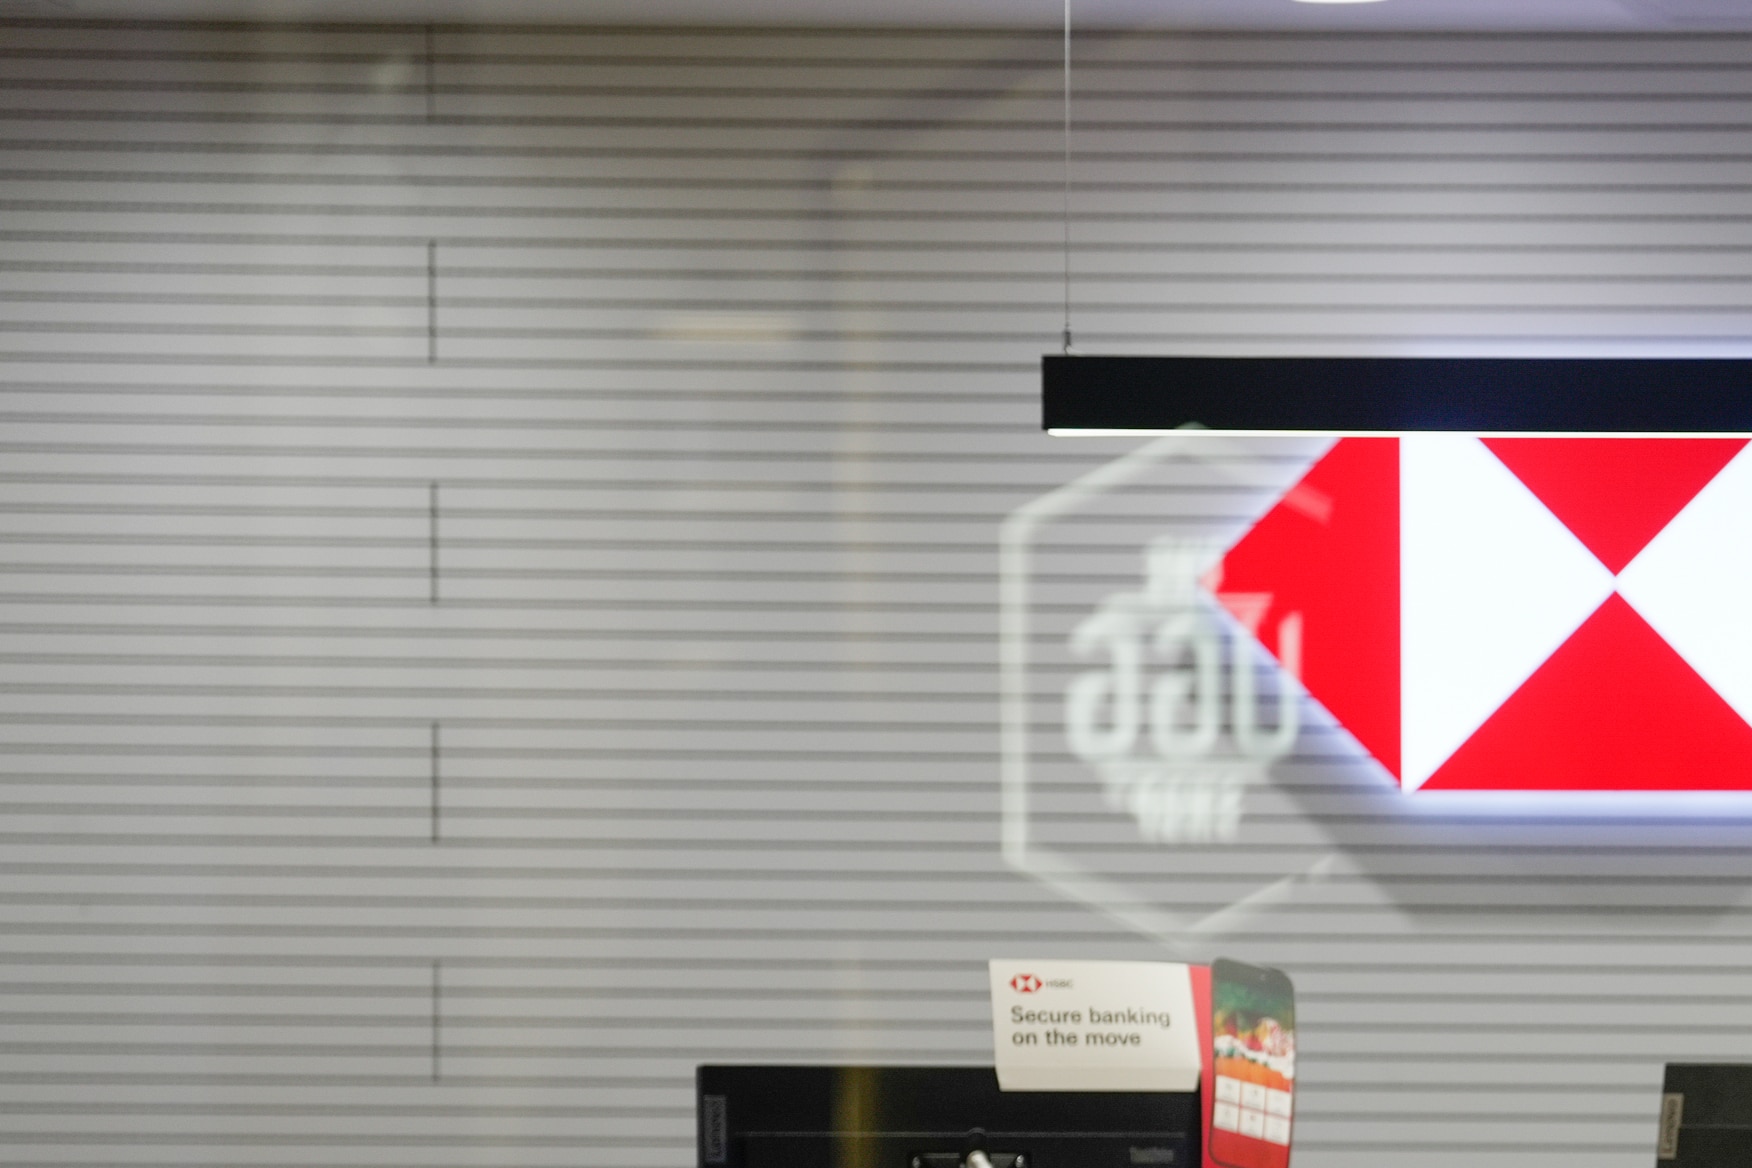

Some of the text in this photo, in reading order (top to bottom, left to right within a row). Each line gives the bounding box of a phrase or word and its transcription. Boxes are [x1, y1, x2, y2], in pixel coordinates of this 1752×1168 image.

[1046, 979, 1073, 988] HSBC
[1011, 1005, 1170, 1028] Secure banking
[1012, 1029, 1141, 1045] on the move
